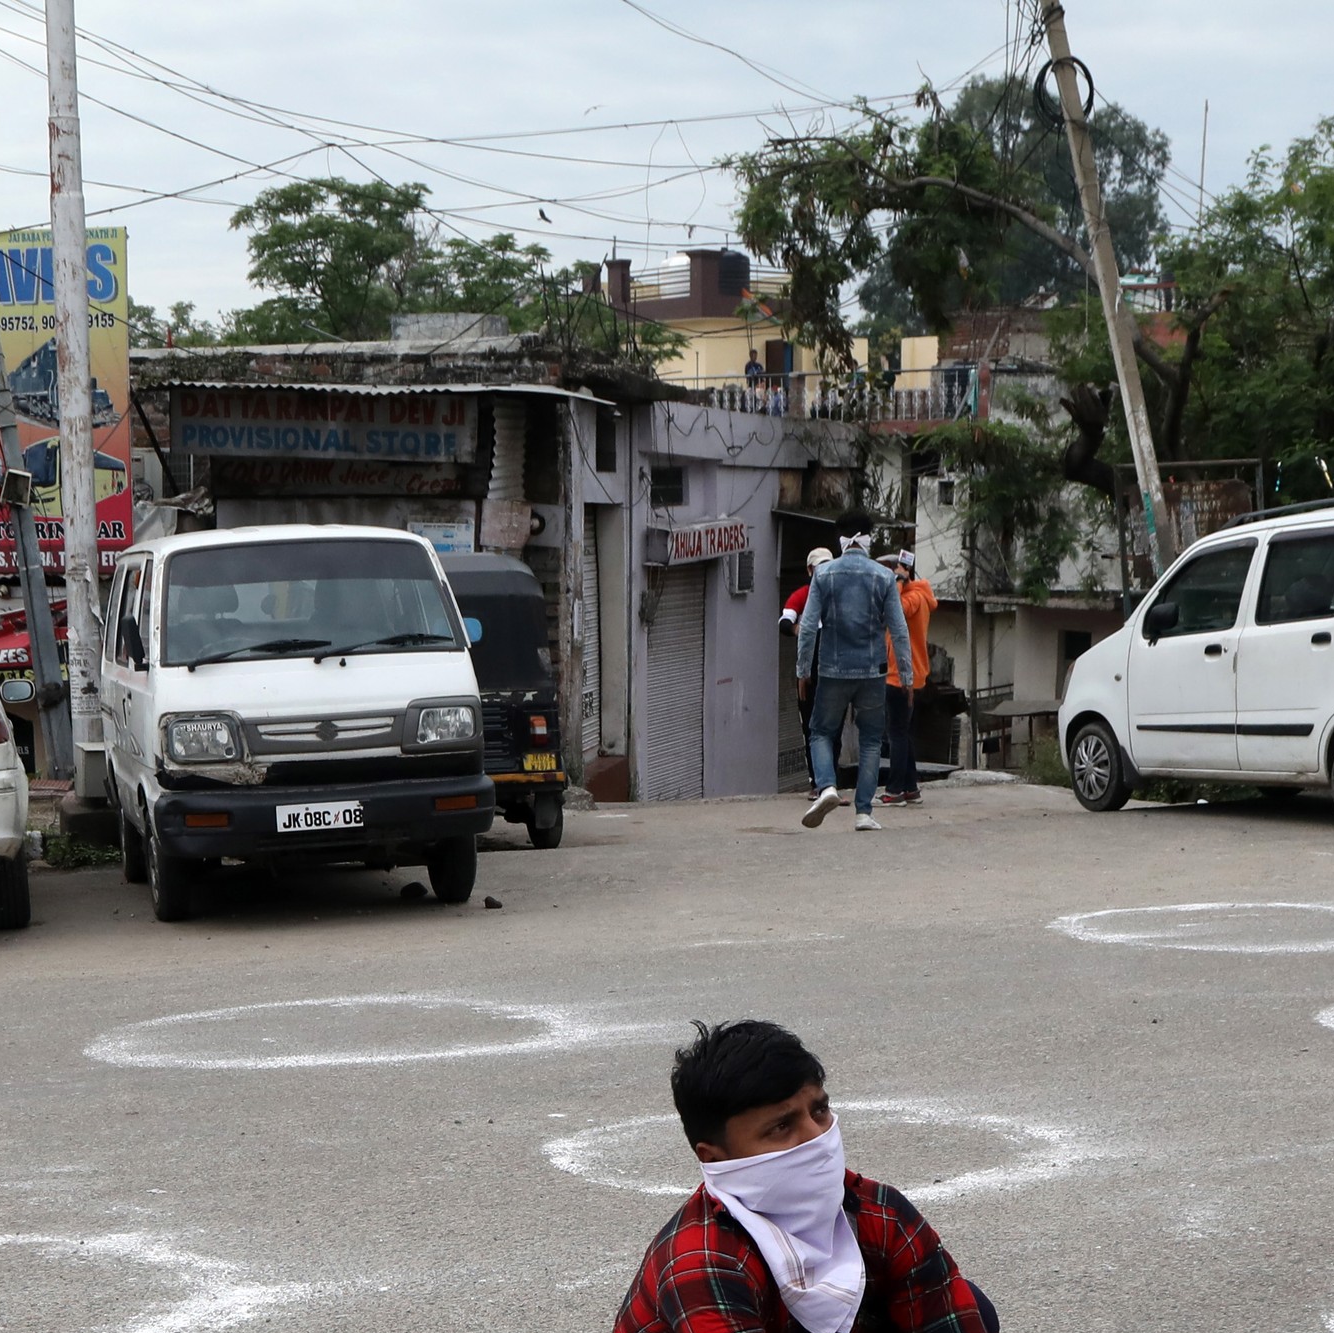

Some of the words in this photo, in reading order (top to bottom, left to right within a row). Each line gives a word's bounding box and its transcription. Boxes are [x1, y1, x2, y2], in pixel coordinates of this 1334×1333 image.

[181, 393, 270, 420] DATTA
[389, 396, 436, 426] DEV
[442, 398, 466, 426] JI
[182, 424, 357, 454] PROVISIONAL
[366, 430, 456, 456] STORE
[674, 530, 702, 560] AHUJA
[705, 524, 746, 556] TRADERS
